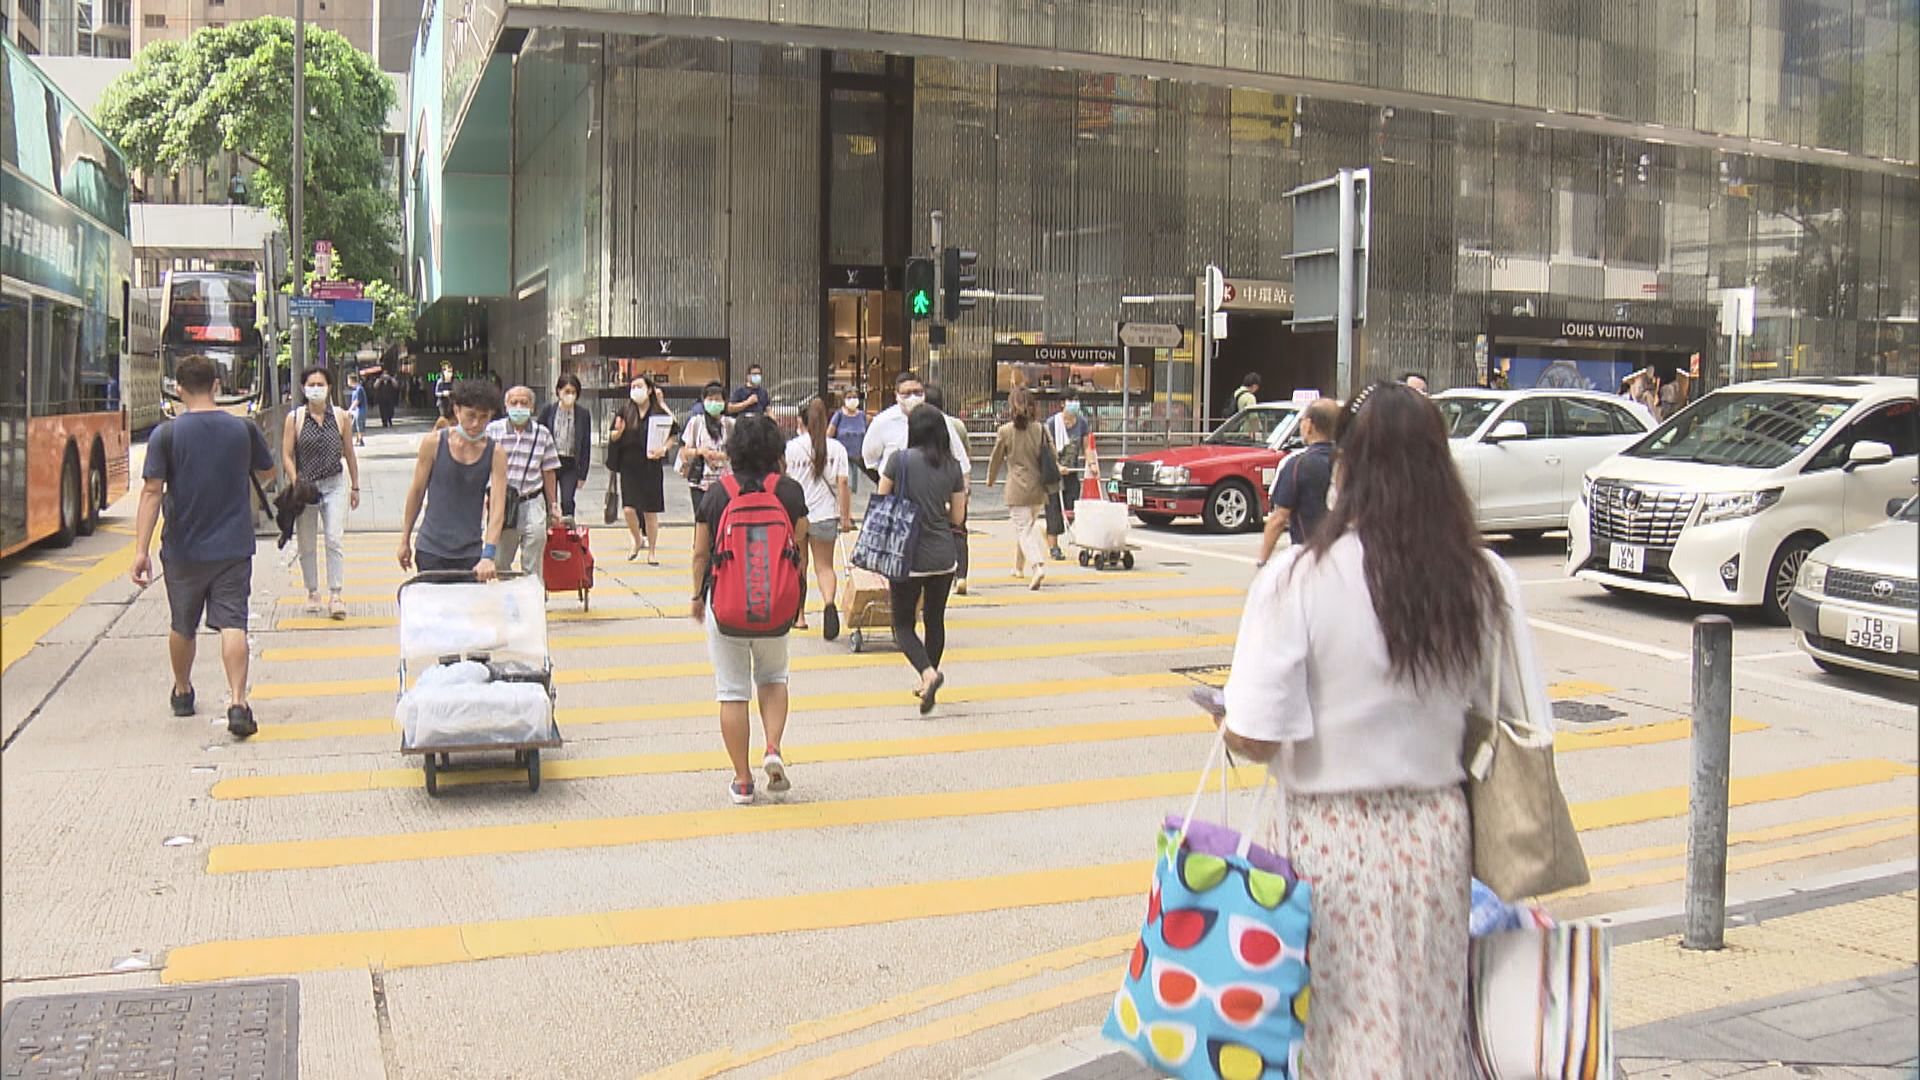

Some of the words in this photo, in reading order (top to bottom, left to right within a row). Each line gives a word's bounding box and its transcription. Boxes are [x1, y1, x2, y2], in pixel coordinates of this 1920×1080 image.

[1243, 285, 1287, 304] 中環站
[1561, 322, 1594, 337] LOUIS
[1597, 324, 1644, 340] VUITTON
[1035, 347, 1067, 359] LOUIS
[1070, 349, 1116, 360] VUITTON
[1620, 545, 1634, 558] VN
[1617, 557, 1634, 569] 184
[1863, 616, 1883, 633] TB
[1850, 630, 1894, 650] 3928
